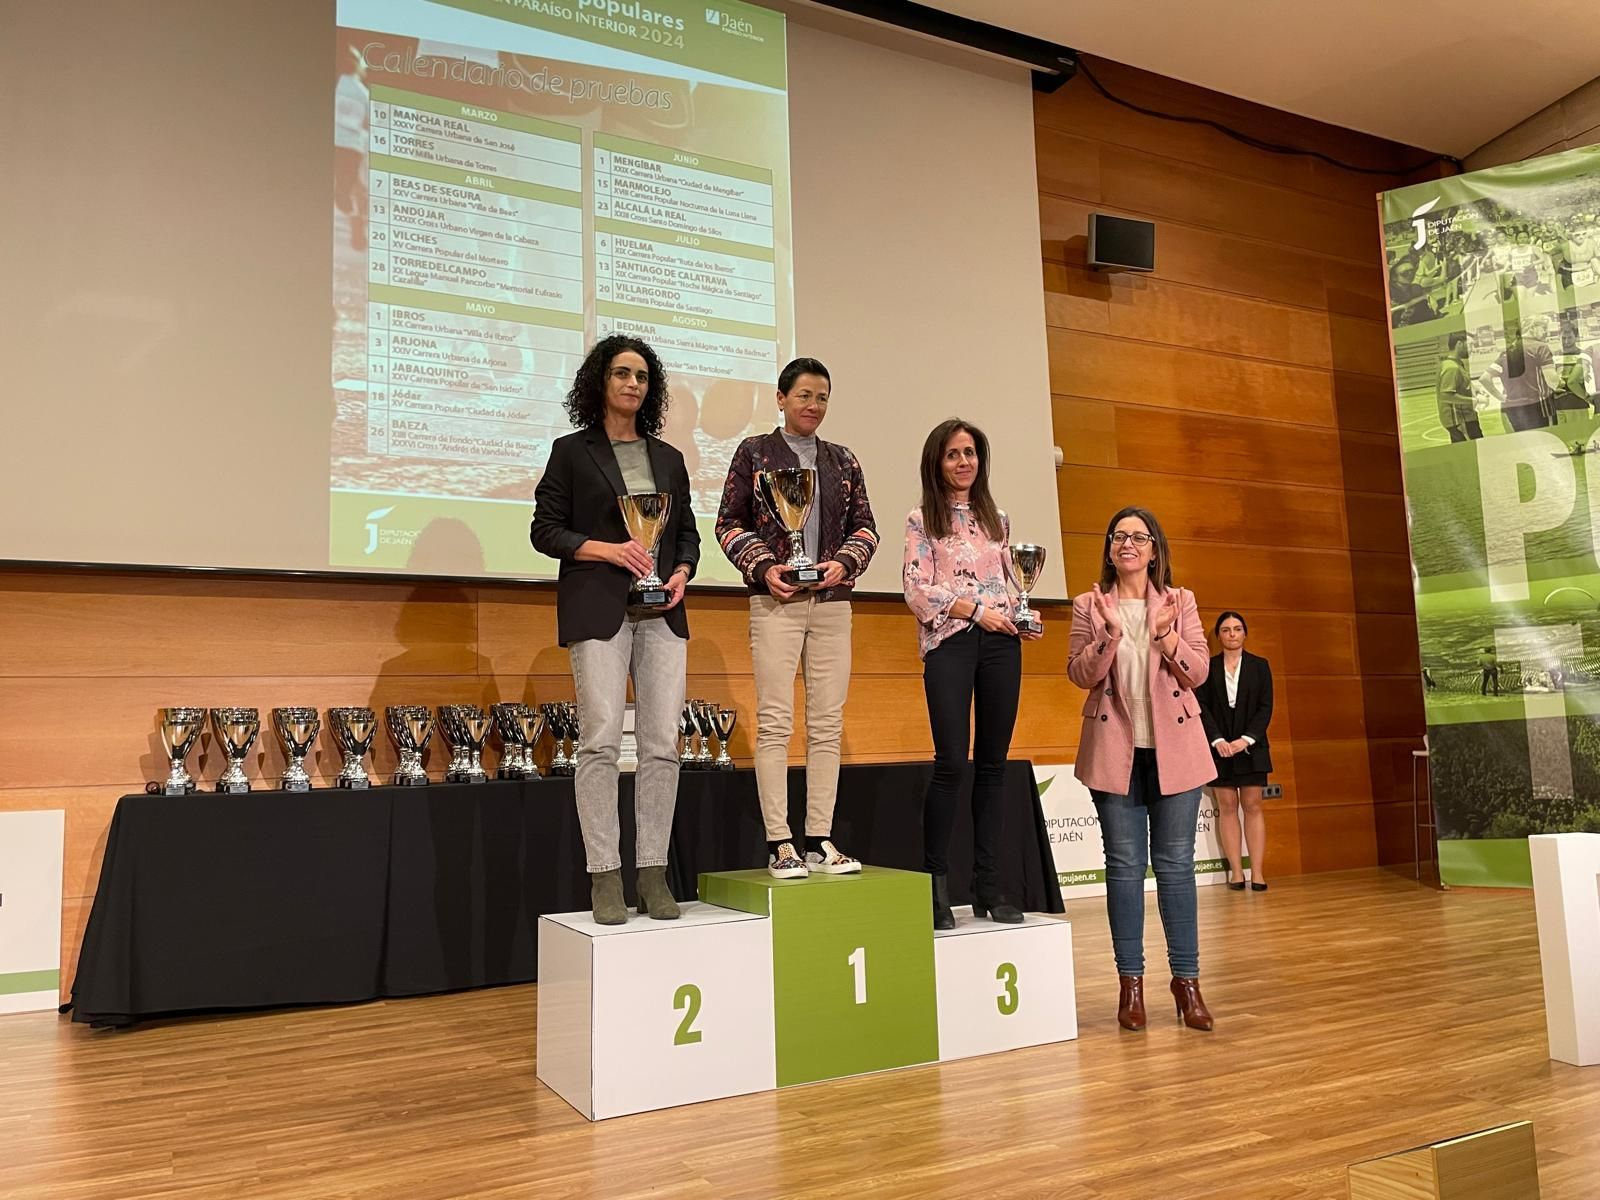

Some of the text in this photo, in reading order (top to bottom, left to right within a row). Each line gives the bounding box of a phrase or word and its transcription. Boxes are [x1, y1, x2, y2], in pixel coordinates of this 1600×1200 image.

[578, 0, 685, 31] populares
[720, 12, 753, 34] Jaén
[576, 12, 638, 38] INTERIOR
[640, 26, 685, 49] 2024
[363, 42, 673, 110] Calendario de pruebas
[374, 110, 387, 120] 10
[394, 109, 470, 133] MANCHA REAL
[462, 107, 498, 122] MARZO
[374, 135, 386, 145] 16
[394, 135, 435, 151] TORRES
[445, 130, 472, 143] Urbana
[600, 157, 604, 165] 1
[614, 155, 662, 174] MENGÍBAR
[673, 154, 699, 167] JUNIO
[376, 180, 383, 189] 7
[465, 176, 495, 189] ABRIL
[598, 179, 608, 189] 15
[614, 179, 671, 197] MARMOLEJO
[393, 178, 481, 202] BEAS DE SEGURA
[374, 205, 385, 215] 13
[393, 204, 445, 221] ANDÚJAR
[598, 202, 609, 211] 23
[615, 200, 687, 222] ALCALÁ LA REAL
[372, 232, 386, 241] 20
[393, 230, 438, 246] VILCHES
[676, 235, 700, 247] JULIO
[601, 239, 607, 248] 6
[615, 238, 654, 252] HUELMA
[372, 263, 385, 272] 28
[393, 256, 487, 279] TORREDELCAMPO
[599, 262, 610, 271] 13
[616, 261, 728, 287] SANTIAGO DE CALATRAVA
[599, 285, 610, 294] 20
[616, 283, 681, 301] VILLARGORDO
[465, 302, 496, 315] MAYO
[376, 312, 381, 321] 1
[393, 309, 425, 322] IBROS
[672, 316, 708, 328] AGOSTO
[602, 324, 608, 332] 3
[617, 322, 656, 335] BEDMAR
[375, 339, 382, 347] 3
[393, 336, 437, 350] ARJONA
[372, 364, 384, 374] 11
[392, 363, 469, 380] JABALQUINTO
[372, 393, 385, 401] 18
[392, 389, 422, 401] Jódar
[371, 428, 385, 437] 26
[392, 420, 429, 432] BAEZA
[1057, 830, 1083, 843] JAÉN
[848, 947, 867, 1005] 1
[995, 961, 1019, 1016] 3
[672, 983, 703, 1046] 2
